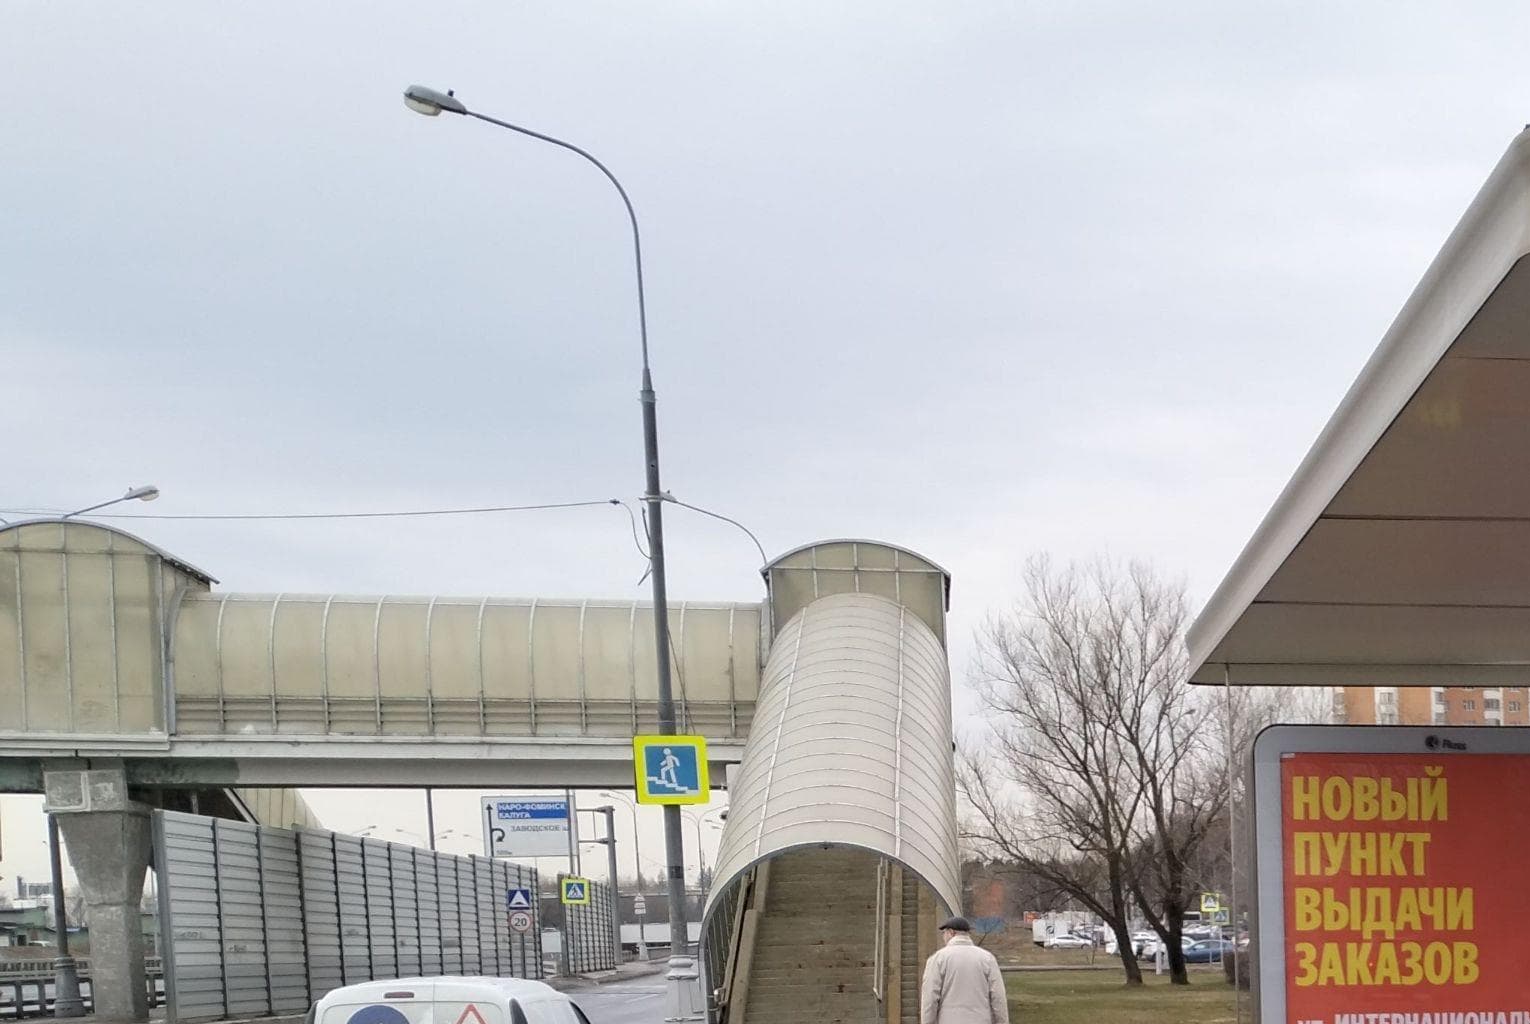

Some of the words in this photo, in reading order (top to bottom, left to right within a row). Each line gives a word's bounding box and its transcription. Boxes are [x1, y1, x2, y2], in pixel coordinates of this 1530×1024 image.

[1292, 765, 1448, 822] НОВЫЙ
[1293, 832, 1432, 877] ПУНКТ
[514, 917, 528, 927] 20
[1294, 887, 1475, 940] ВЫДАЧИ
[1294, 941, 1480, 987] ЗАКАЗОВ
